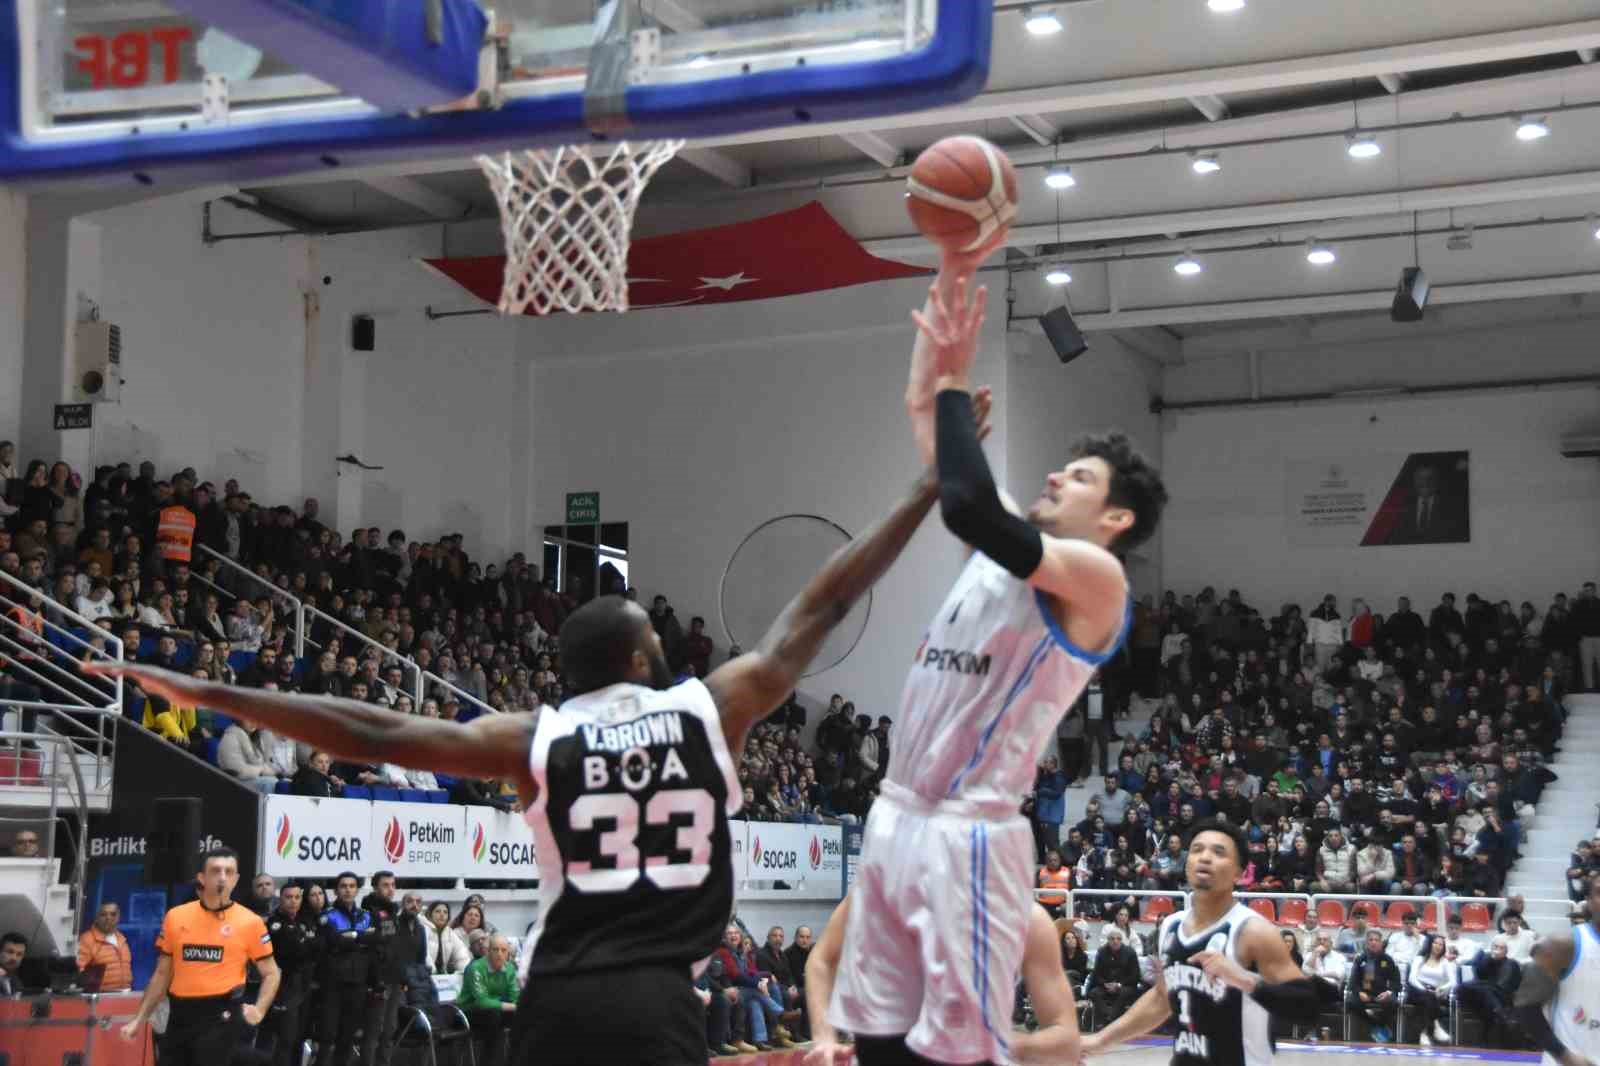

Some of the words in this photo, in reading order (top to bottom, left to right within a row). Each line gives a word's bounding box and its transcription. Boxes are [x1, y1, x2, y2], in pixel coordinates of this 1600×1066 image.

[583, 710, 684, 752] V.BROWN
[409, 821, 455, 844] Petkim
[567, 788, 715, 893] 33
[90, 836, 147, 856] Birlikt
[298, 835, 361, 861] SOCAR
[408, 850, 441, 864] SPOR
[763, 850, 797, 869] SOCAR
[1178, 989, 1190, 1024] 1
